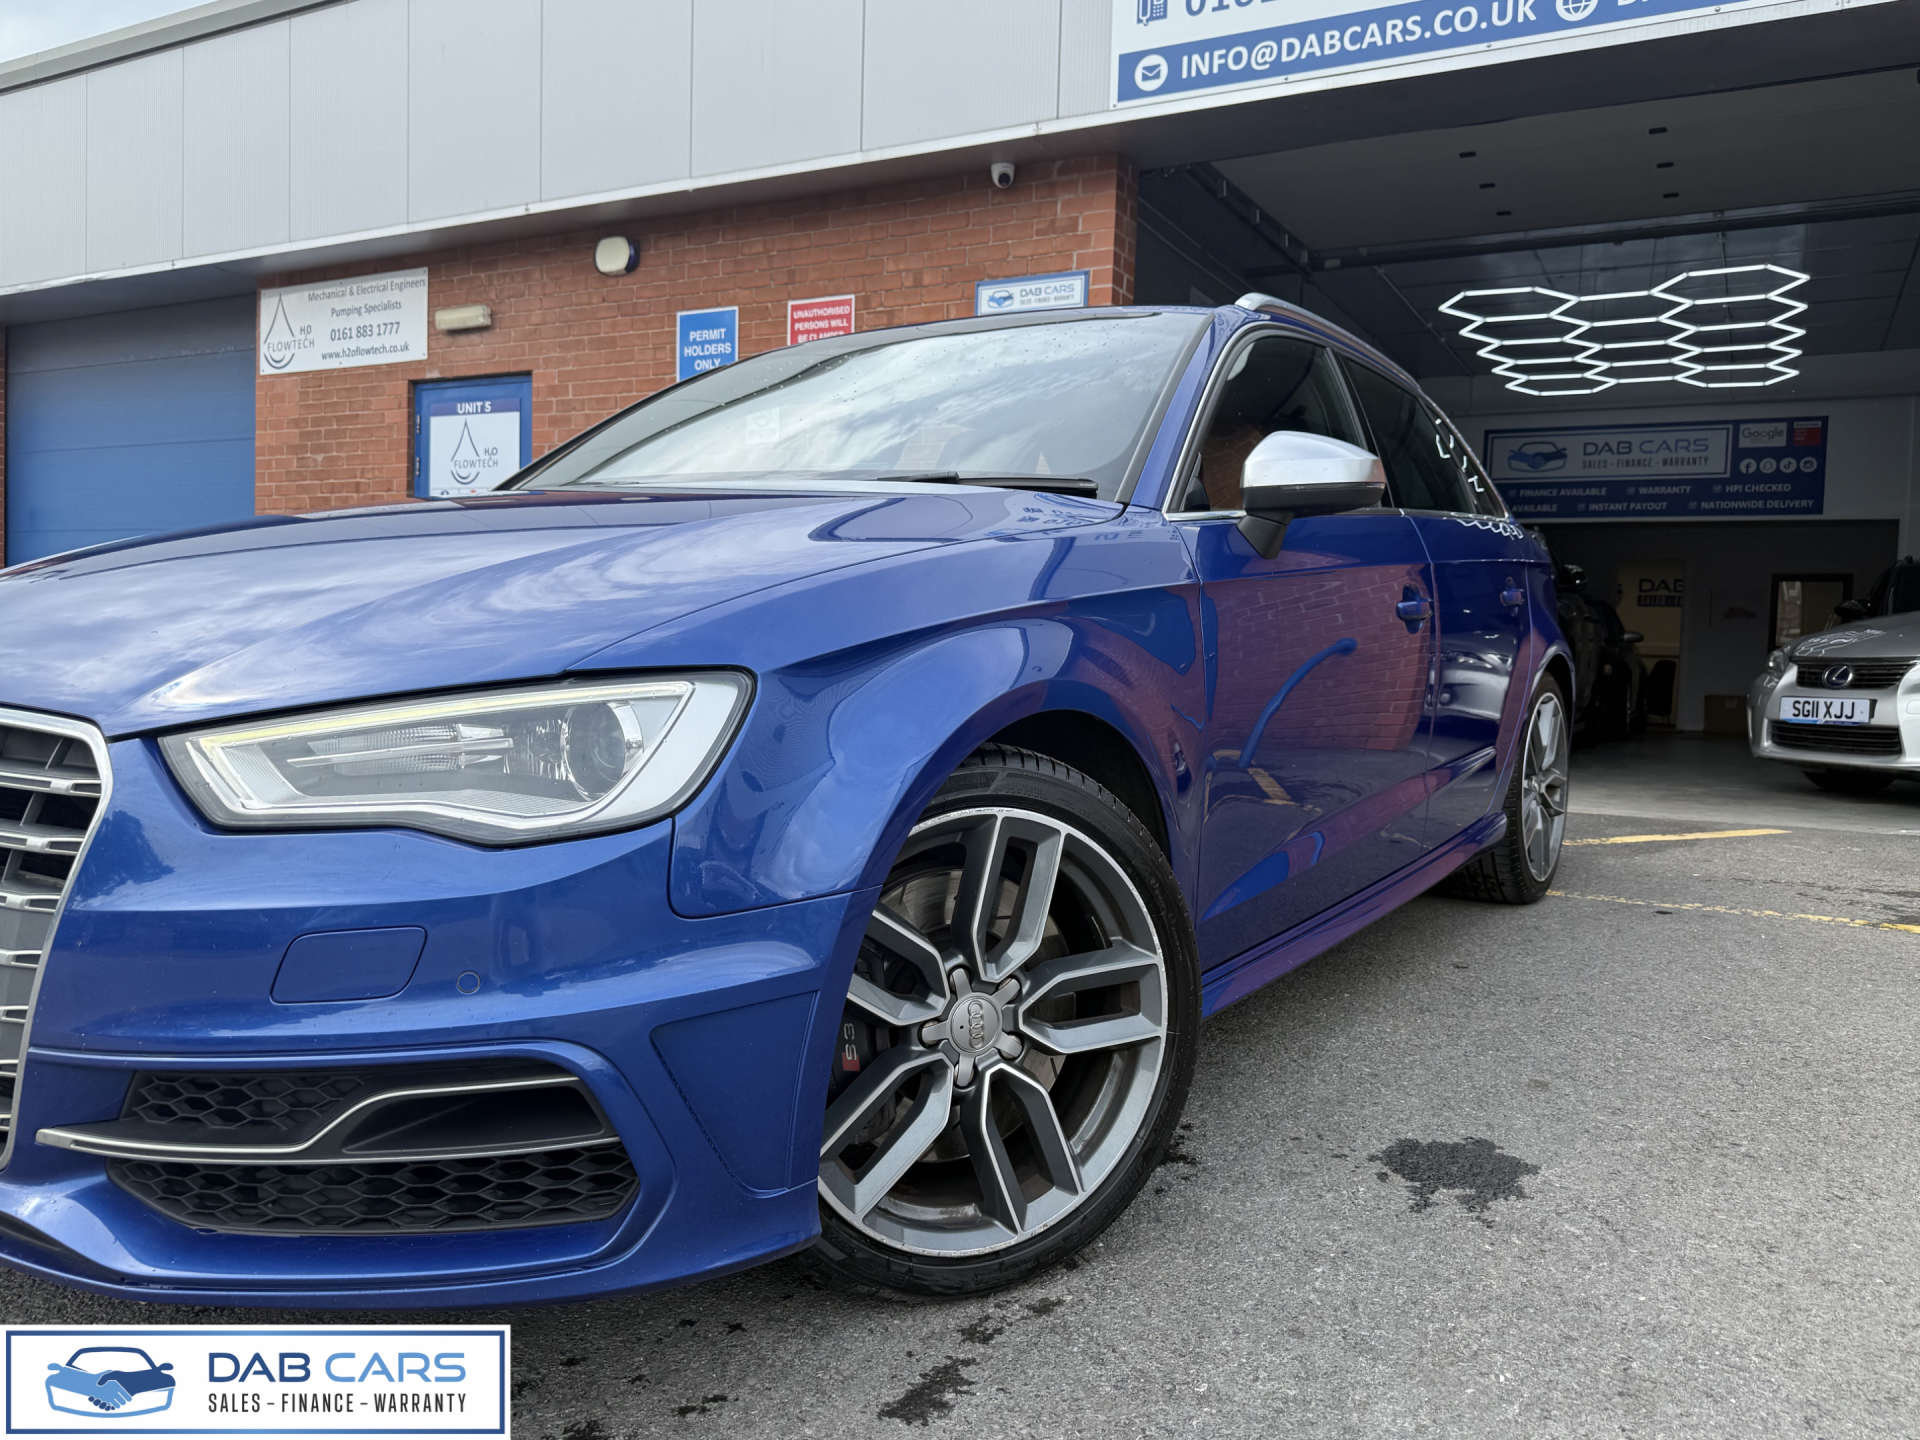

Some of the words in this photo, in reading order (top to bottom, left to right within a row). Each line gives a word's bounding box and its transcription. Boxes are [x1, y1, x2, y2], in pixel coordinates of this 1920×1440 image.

[1181, 0, 1536, 79] INFO@DABCARS.CO.UK
[308, 287, 347, 302] Mechanical
[349, 286, 354, 296] &
[356, 281, 388, 296] Electrical
[390, 278, 426, 292] Engineers
[1020, 287, 1042, 298] DAB
[1044, 283, 1074, 295] CARS
[331, 305, 362, 318] Pumping
[364, 300, 402, 315] Specialists
[793, 305, 850, 319] UNAUTHORISED
[330, 326, 353, 342] 0161
[356, 323, 374, 339] 883
[377, 321, 401, 336] 1777
[794, 320, 829, 331] PERSONS
[830, 318, 848, 327] WILL
[689, 328, 726, 343] PERMIT
[798, 333, 808, 343] BE
[267, 336, 315, 352] FLOWTECH
[322, 341, 410, 360] www.h2oflowtech.co.uk
[684, 343, 732, 357] HOLDERS
[694, 358, 721, 370] ONLY
[457, 401, 483, 413] UNIT
[1742, 426, 1784, 441] Google
[1583, 440, 1632, 456] DAB
[1639, 438, 1709, 454] CARS
[454, 458, 498, 469] FLOWTECH
[1617, 457, 1652, 468] FINANCE
[1662, 455, 1709, 467] WARRANTY
[1520, 487, 1558, 497] FINANCE
[1559, 487, 1607, 497] AVAILABLE
[1638, 485, 1692, 495] WARRANTY
[1726, 484, 1743, 493] HPI
[1744, 483, 1792, 493] CHECKED
[1511, 503, 1558, 513] AVAILABLE
[1588, 502, 1627, 512] INSTANT
[1629, 501, 1667, 511] PAYOUT
[1701, 500, 1766, 510] NATIONWIDE
[1766, 499, 1815, 509] DELIVERY
[1792, 700, 1819, 718] SG11
[1823, 701, 1855, 719] XJJ
[843, 1023, 857, 1061] S3
